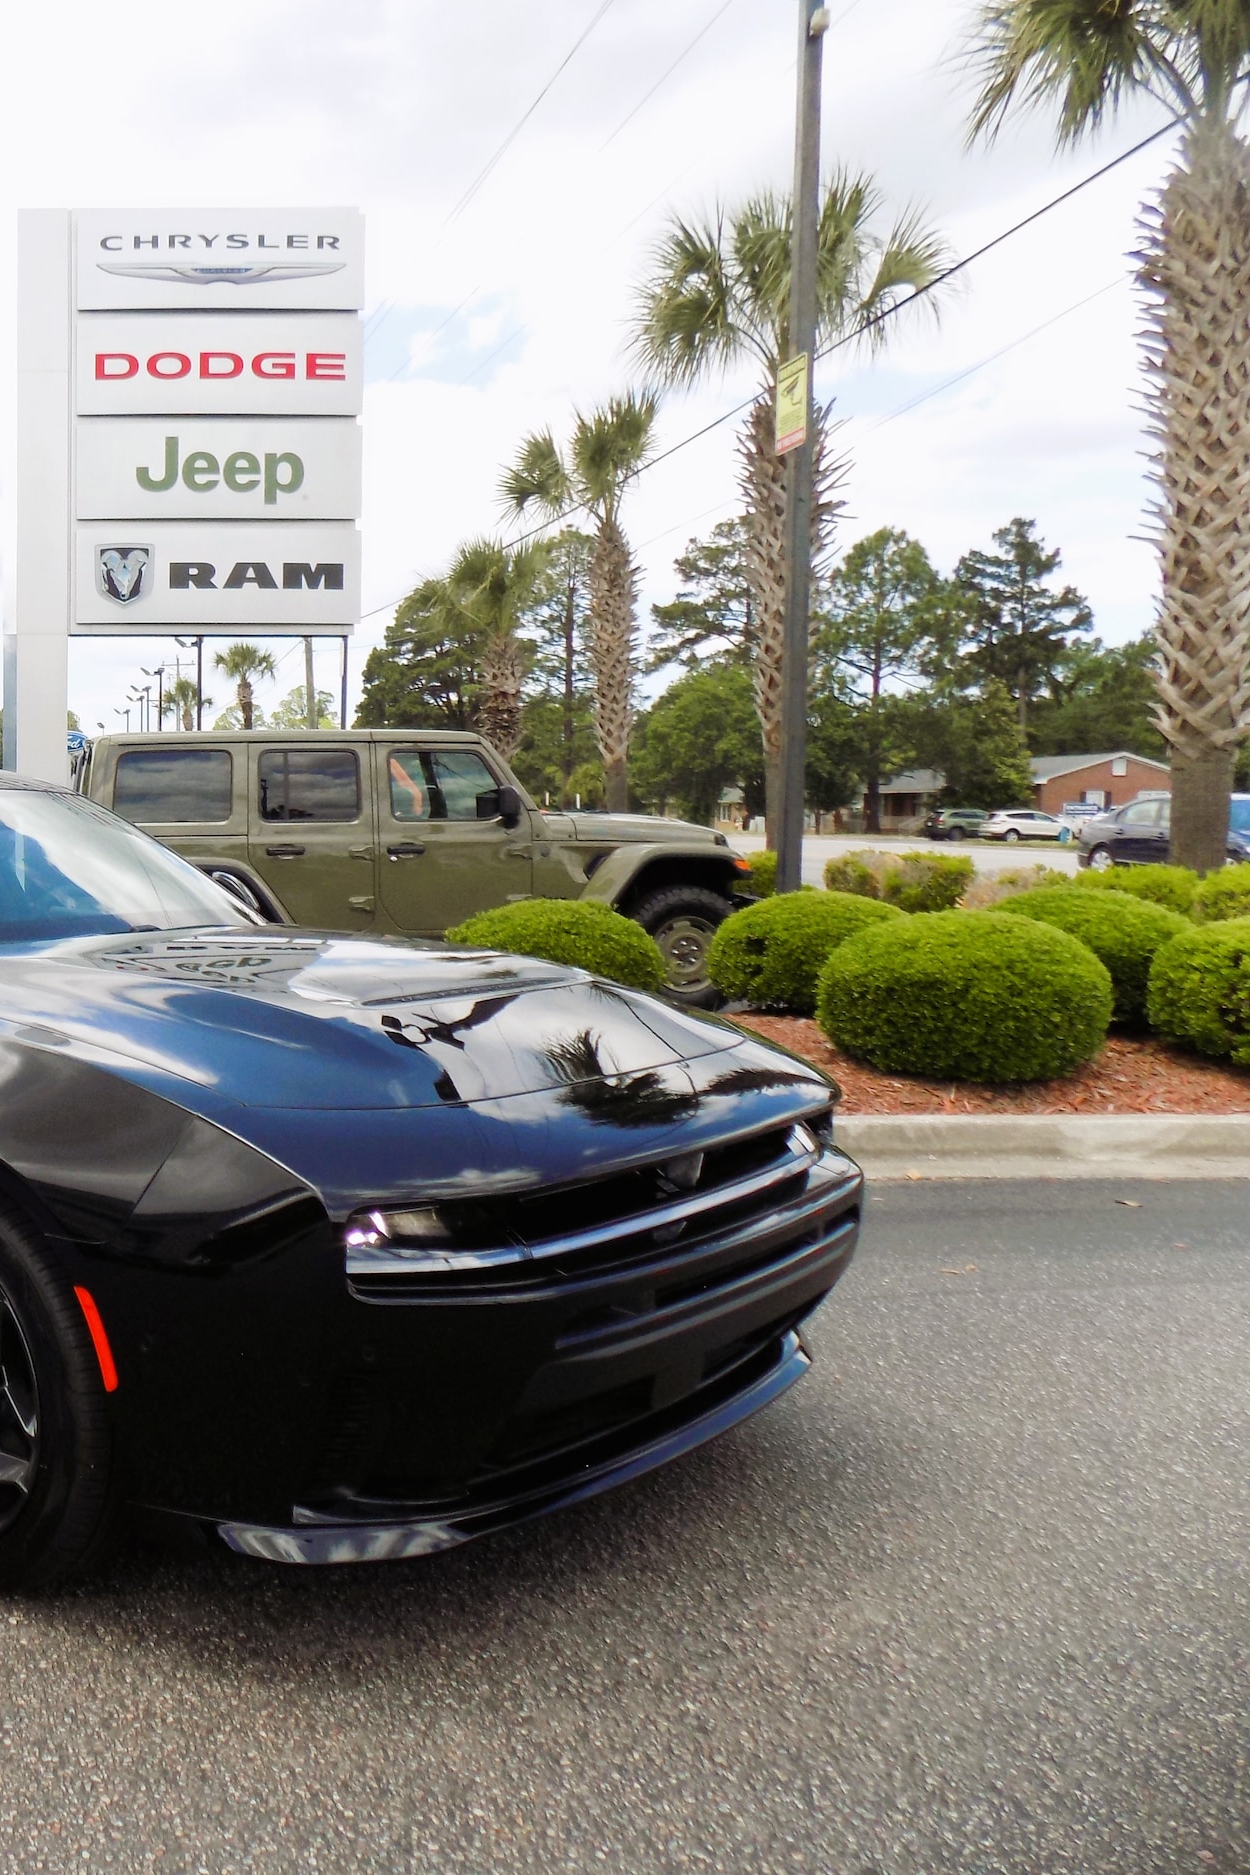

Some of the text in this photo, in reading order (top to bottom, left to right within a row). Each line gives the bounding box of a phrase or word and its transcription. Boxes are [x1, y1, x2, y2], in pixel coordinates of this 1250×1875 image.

[100, 234, 341, 251] CHRYSLER
[95, 352, 346, 380] DODGE
[136, 436, 305, 504] Jeep
[169, 562, 345, 590] RAM
